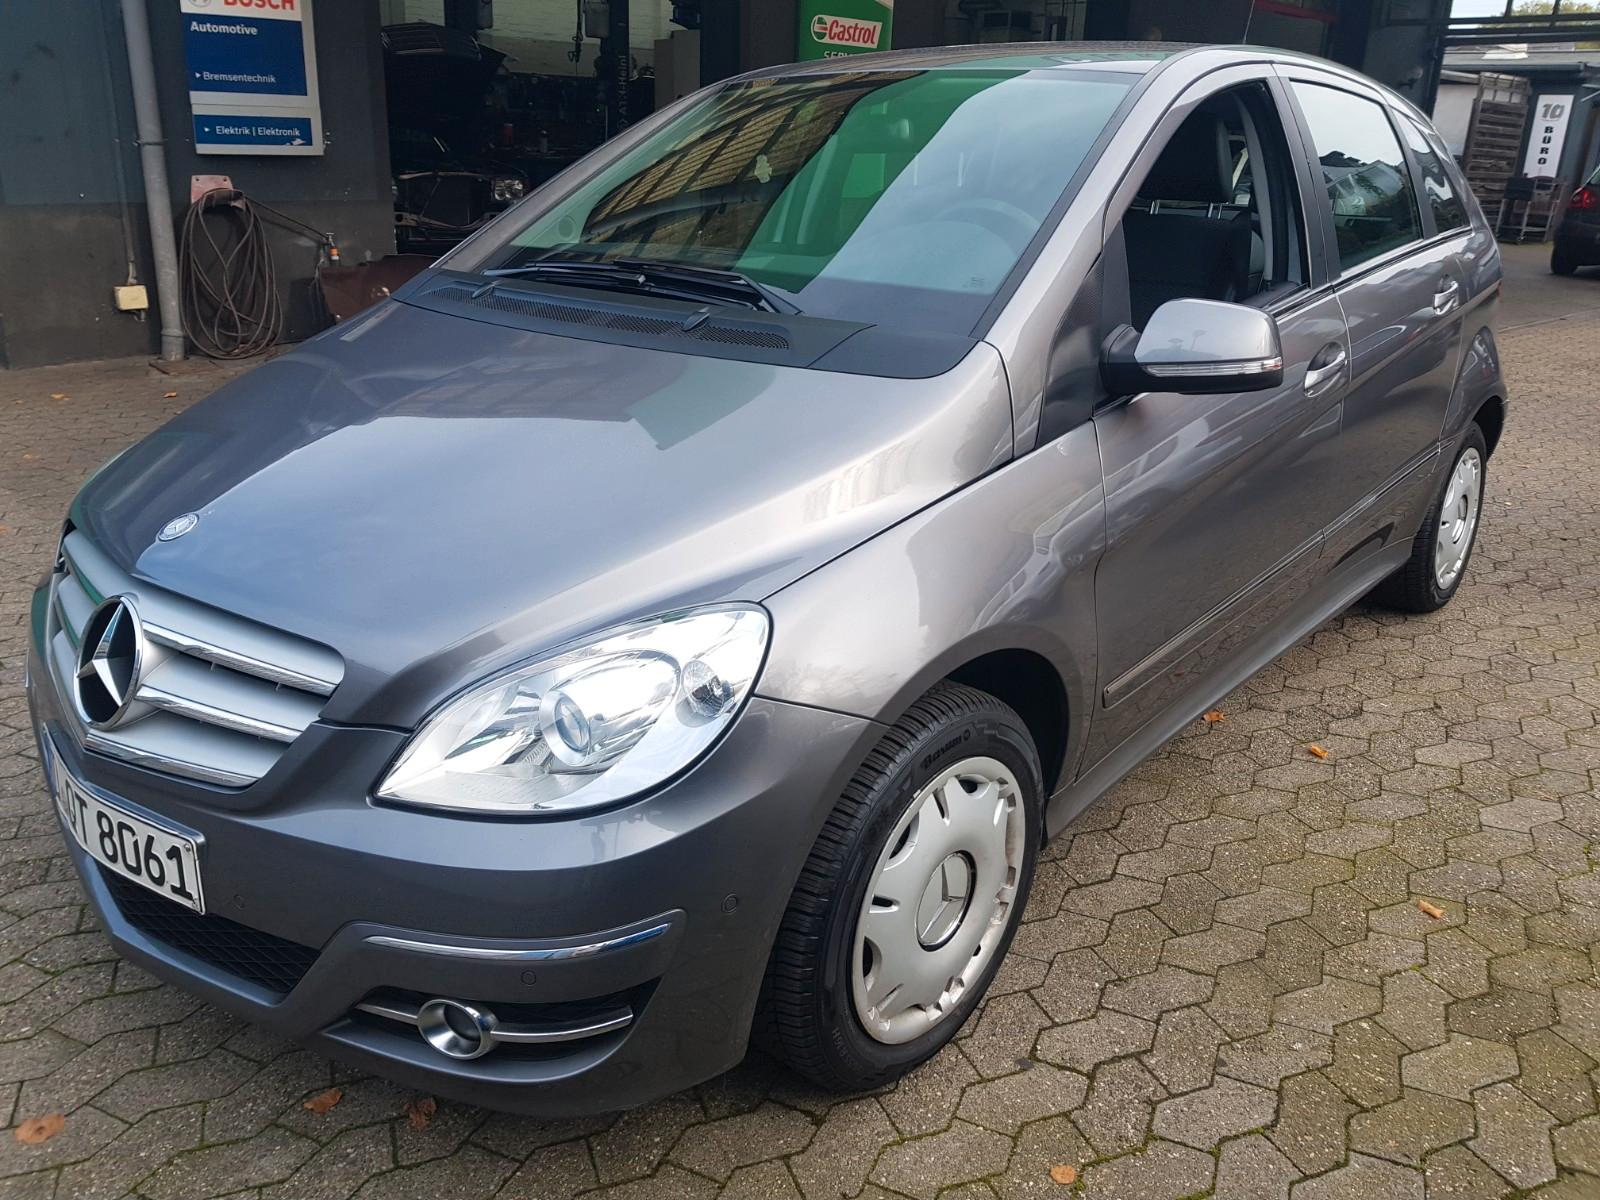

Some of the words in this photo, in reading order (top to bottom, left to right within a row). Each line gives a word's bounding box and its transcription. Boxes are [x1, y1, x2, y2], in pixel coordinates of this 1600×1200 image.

[190, 21, 258, 35] Automotive
[828, 20, 877, 45] Castrol
[203, 71, 276, 83] Bremsentechnik
[1541, 103, 1565, 119] 10
[216, 126, 251, 136] Elektrik
[257, 127, 301, 137] Elektronik
[97, 810, 195, 901] 8061
